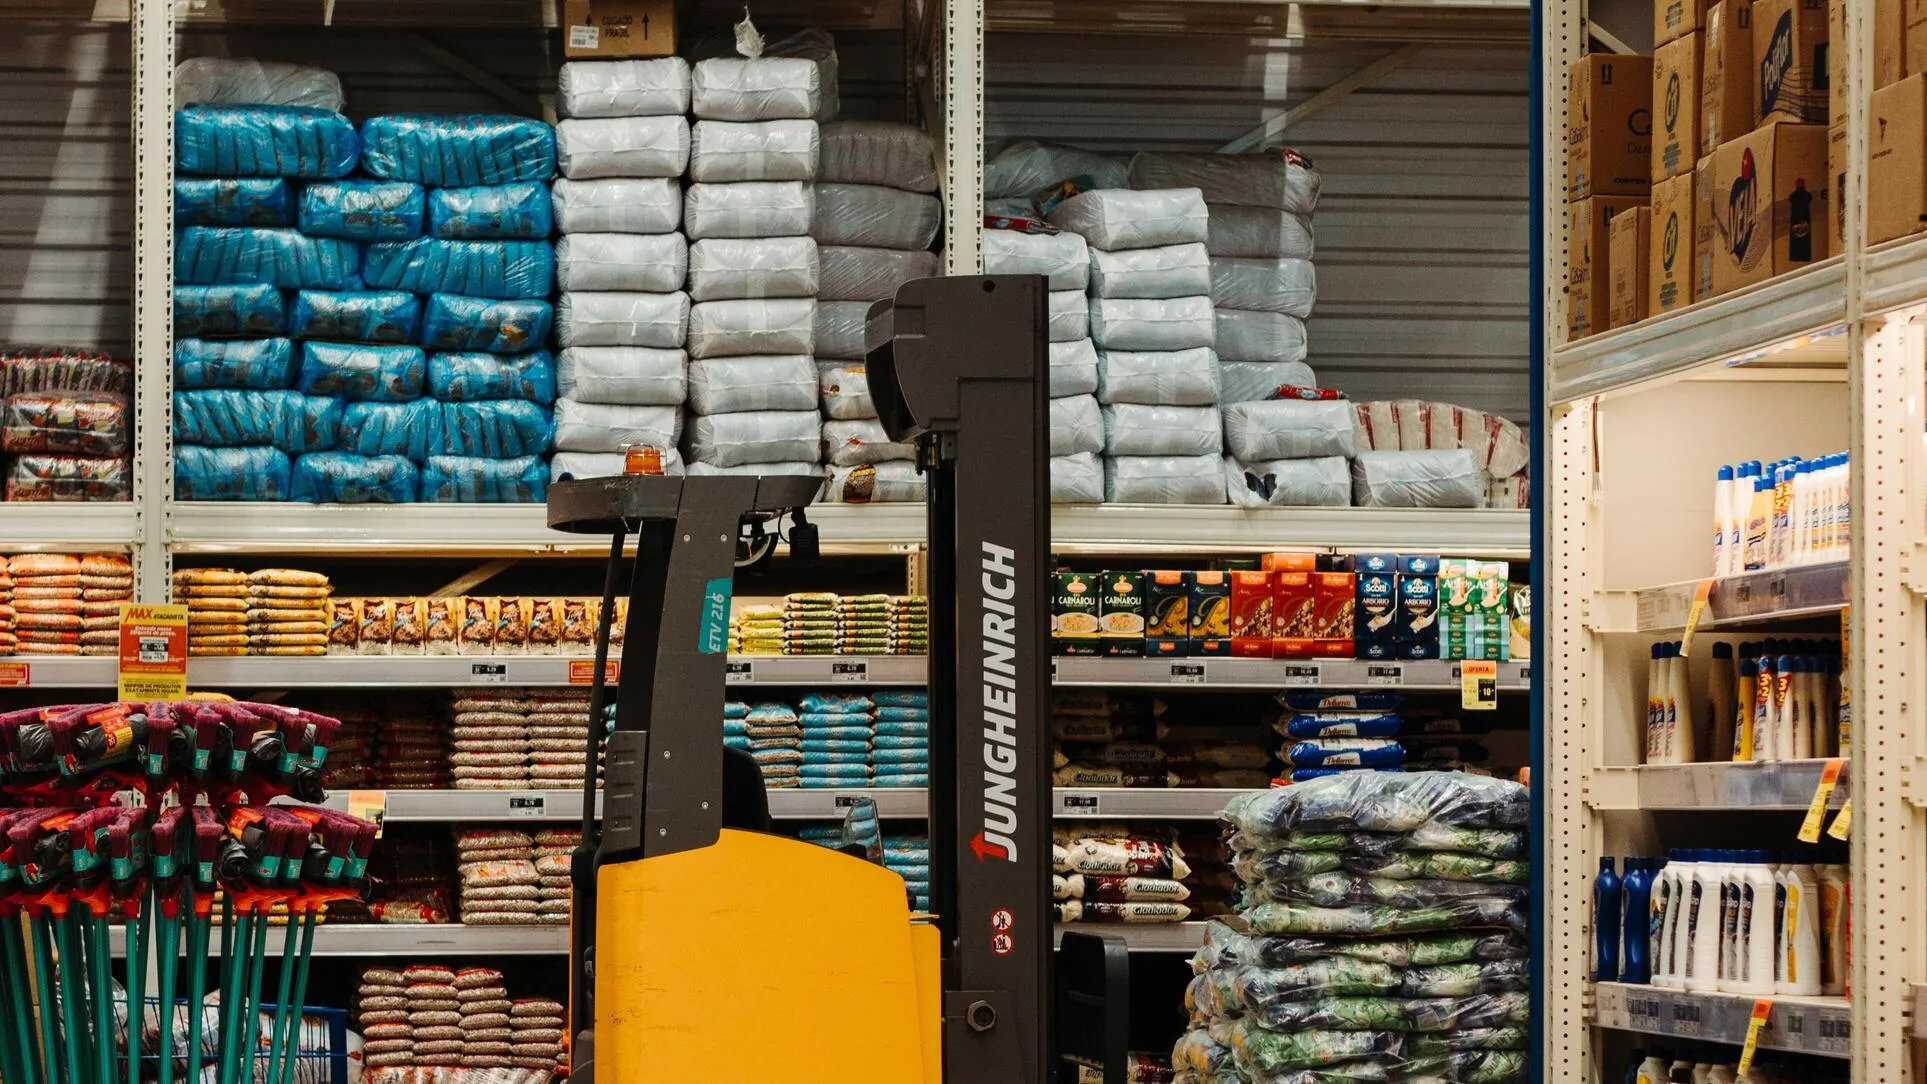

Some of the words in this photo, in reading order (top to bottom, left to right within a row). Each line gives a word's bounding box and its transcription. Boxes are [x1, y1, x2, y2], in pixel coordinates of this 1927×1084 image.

[1365, 583, 1387, 593] Scotti
[1407, 583, 1429, 593] Scotti
[1058, 596, 1095, 605] CARNAROLI
[1105, 596, 1141, 605] CARNAROLI
[711, 592, 724, 621] 216
[125, 607, 153, 623] MAX
[709, 622, 722, 653] ETV
[1779, 678, 1788, 690] 3
[982, 541, 1017, 863] JUNGHEINRICH
[1079, 860, 1122, 871] Gladiador
[1135, 883, 1180, 894] Gladiador
[1133, 905, 1178, 916] Gladiador
